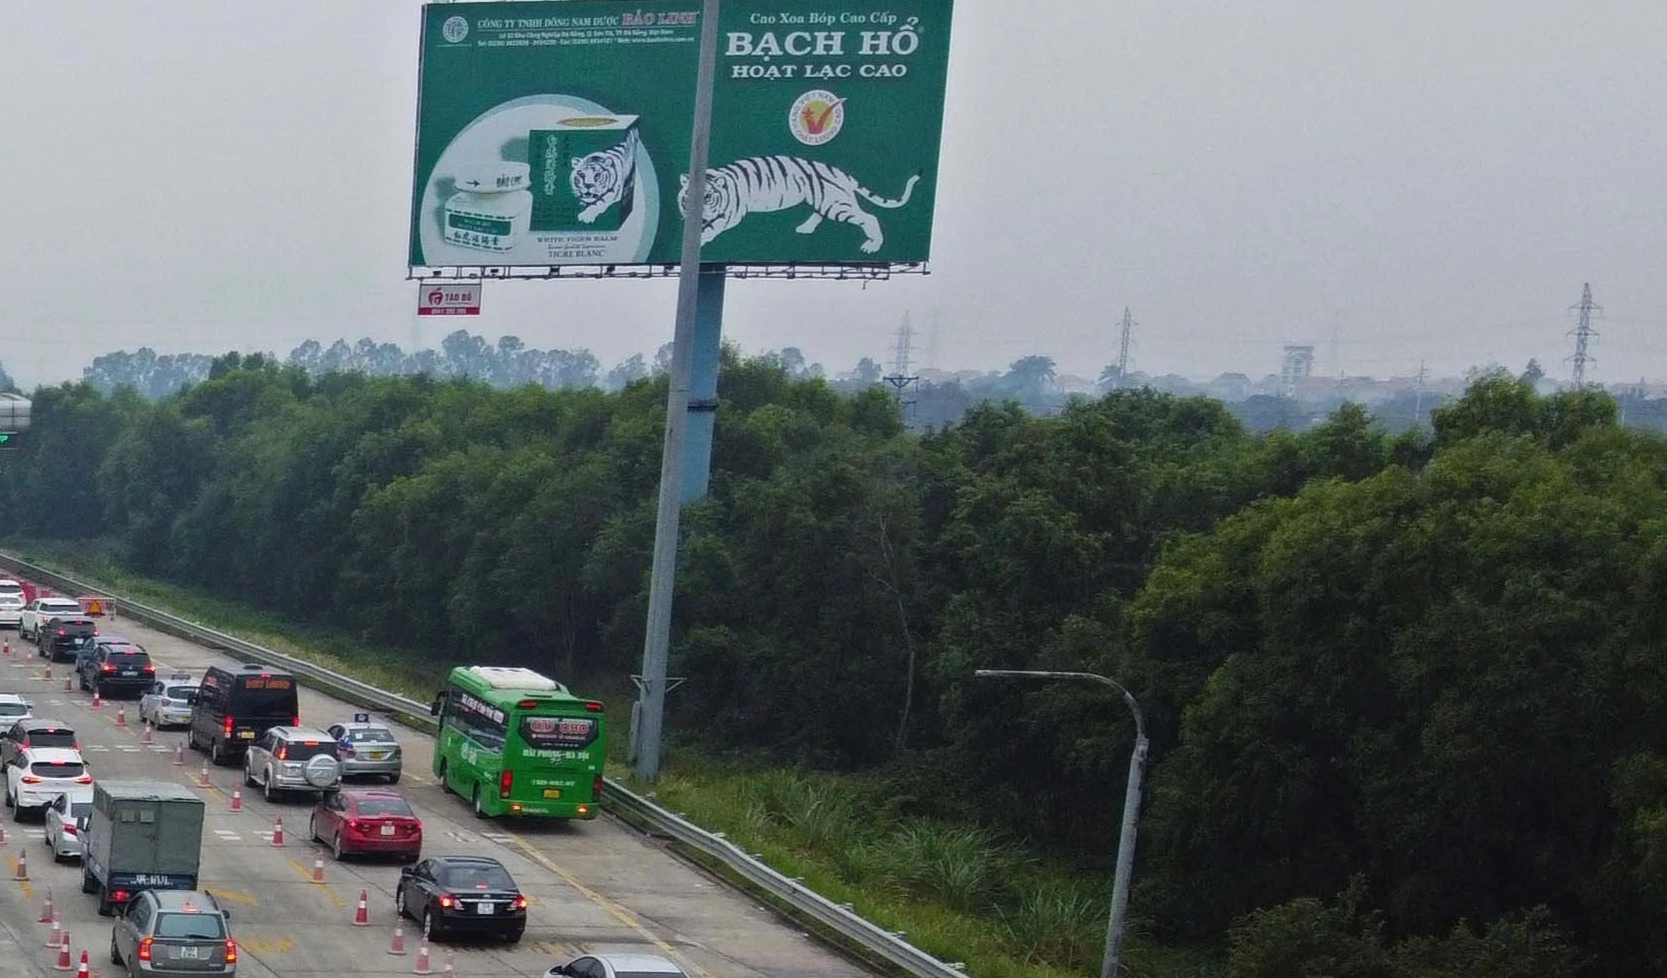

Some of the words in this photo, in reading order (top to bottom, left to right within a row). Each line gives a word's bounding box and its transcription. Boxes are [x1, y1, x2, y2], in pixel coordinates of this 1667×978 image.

[750, 13, 776, 24] Cao
[780, 13, 805, 24] Xoa
[809, 12, 836, 27] Bóp
[840, 12, 866, 24] Cao
[870, 11, 898, 26] Cấp
[725, 32, 845, 62] BẠCH
[858, 16, 919, 56] HỔ
[731, 65, 797, 80] HOẠT
[804, 64, 852, 80] LẠC
[859, 64, 907, 77] CAO
